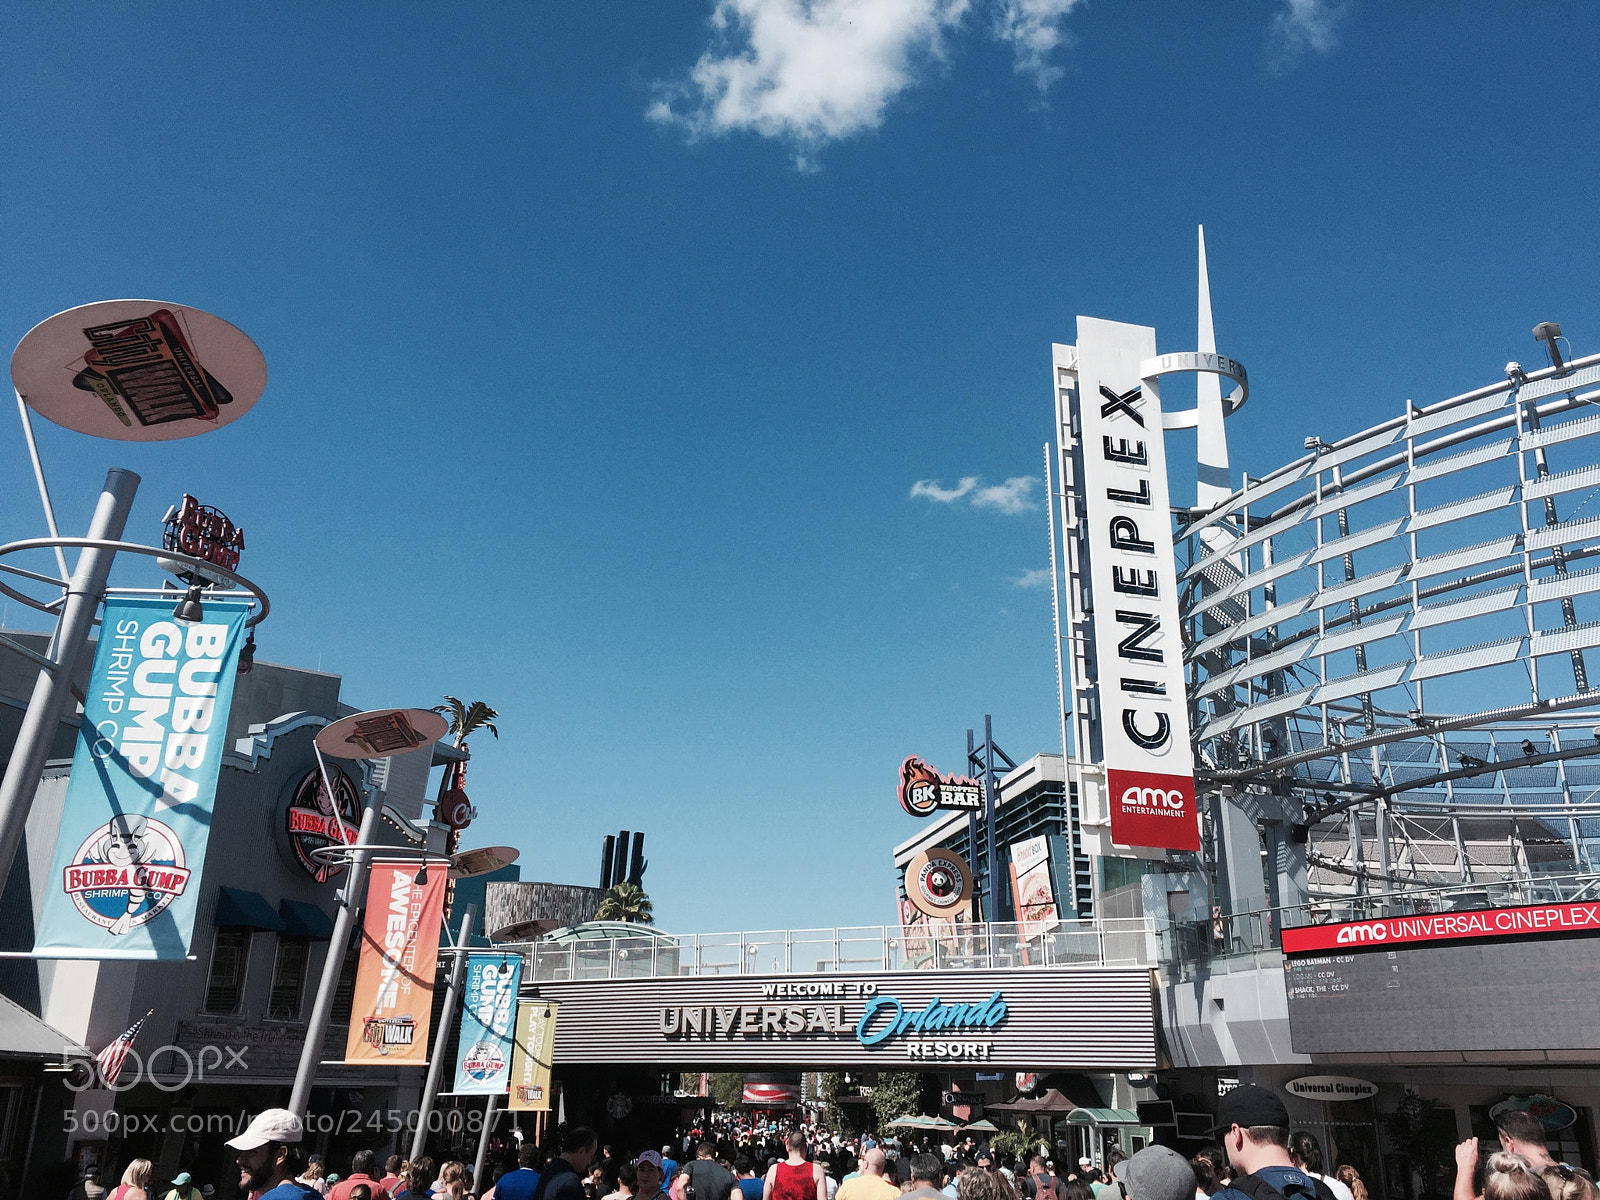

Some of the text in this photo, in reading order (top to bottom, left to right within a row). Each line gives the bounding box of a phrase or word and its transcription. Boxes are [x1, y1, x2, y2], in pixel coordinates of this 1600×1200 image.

[173, 346, 204, 391] UNIVERSAL
[1161, 354, 1246, 378] UNIVERS
[95, 382, 126, 418] ORLANDO
[1100, 382, 1172, 750] CINEPLEX
[101, 619, 139, 714] SHRIMP
[119, 621, 183, 779] GUMP
[154, 623, 229, 813] BUBBA
[912, 785, 936, 804] BK
[940, 784, 979, 793] WHOPPER
[940, 791, 980, 807] BAR
[290, 809, 327, 835] BUBBA
[1122, 805, 1185, 818] ENTERTAINMENT
[69, 866, 186, 892] BUBBA GUMP
[919, 859, 962, 883] PANDA EXPRESS
[84, 889, 129, 899] SHRIMP
[74, 892, 112, 926] RESTAURANT
[1390, 913, 1493, 938] UNIVERSAL
[1495, 906, 1600, 931] CINEPLEX
[375, 869, 412, 1014] AWESOME.
[403, 903, 421, 973] EPICENTER
[1292, 959, 1306, 967] LEGO
[1307, 957, 1331, 966] BATMAN
[401, 976, 412, 995] OF
[470, 964, 482, 1003] SHRIMP
[477, 964, 499, 1027] GUMP
[762, 982, 877, 996] WELCOME TO
[492, 965, 516, 1040] BUBBA
[659, 990, 1008, 1046] UNIVERSAL Orlando
[384, 1025, 413, 1043] WALK
[907, 1041, 992, 1059] RESORT
[1292, 1082, 1372, 1096] Universal Cineplex
